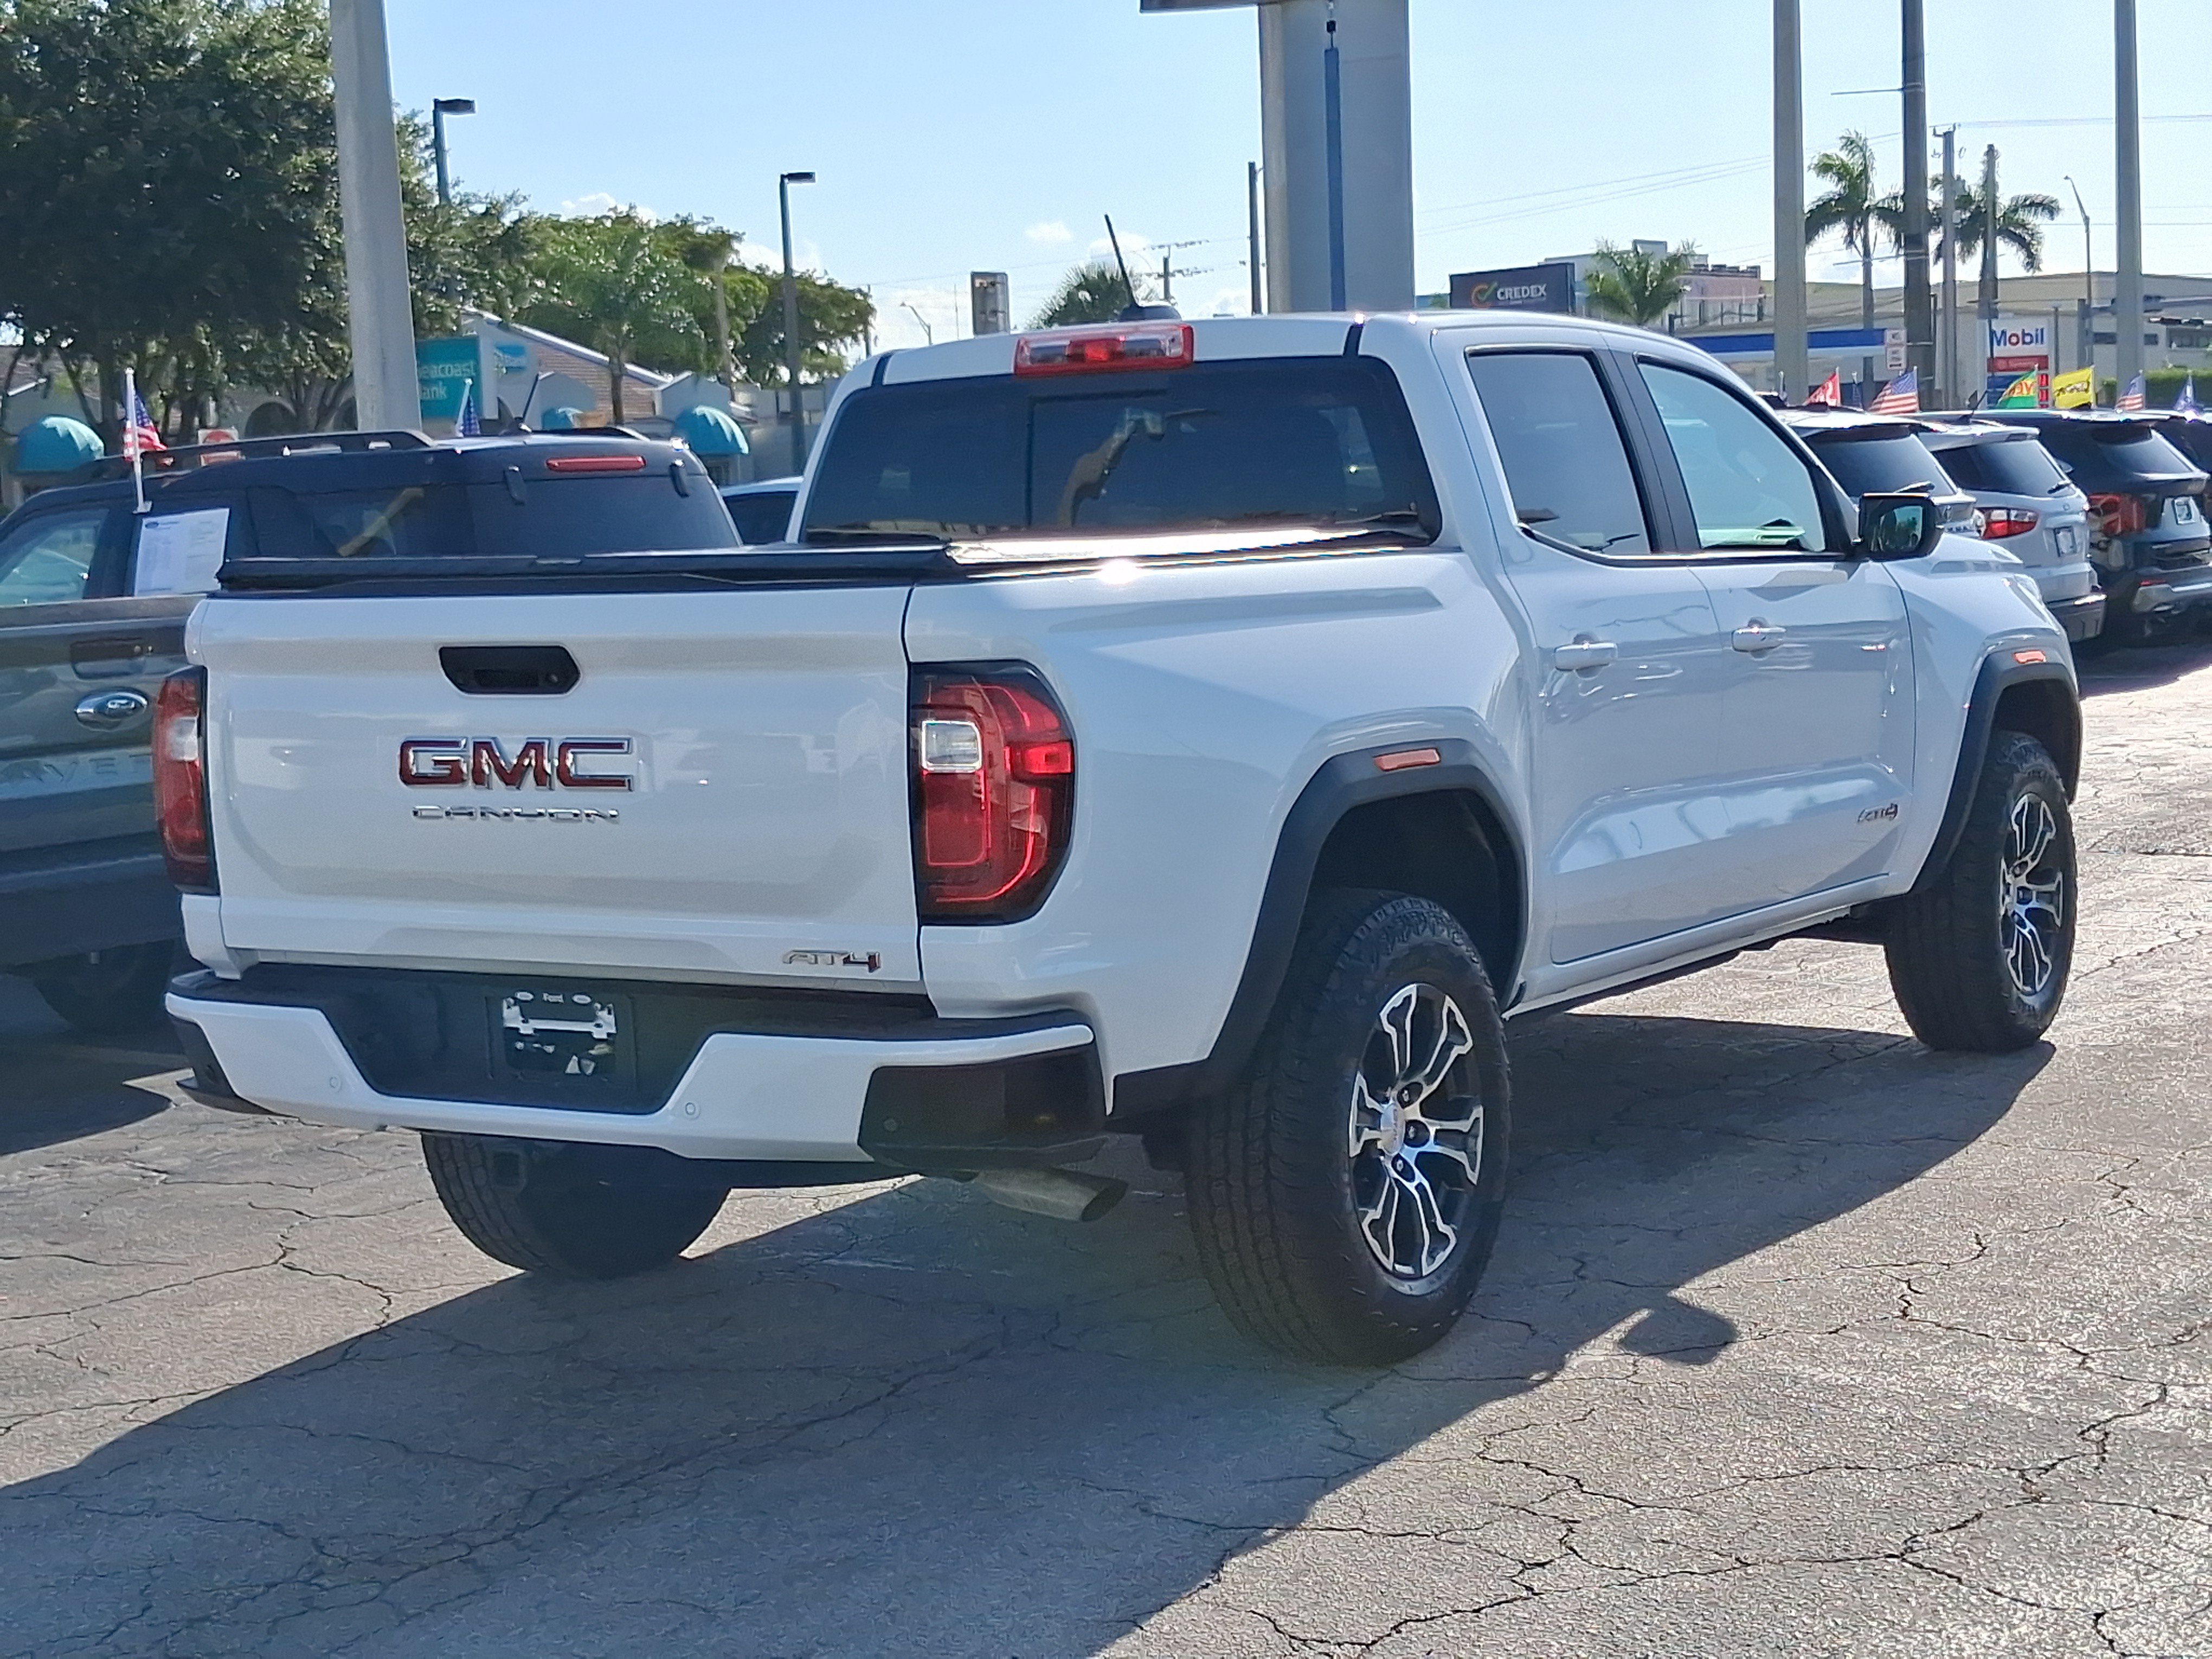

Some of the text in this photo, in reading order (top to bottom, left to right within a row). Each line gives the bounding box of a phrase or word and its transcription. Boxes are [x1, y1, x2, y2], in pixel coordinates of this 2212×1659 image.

[1497, 284, 1547, 300] CREDEX
[1992, 327, 2044, 346] Mobil
[419, 360, 476, 380] eacoast
[420, 380, 447, 401] ank
[399, 736, 633, 791] GMC
[412, 805, 619, 824] CANYON
[783, 949, 881, 973] AT4
